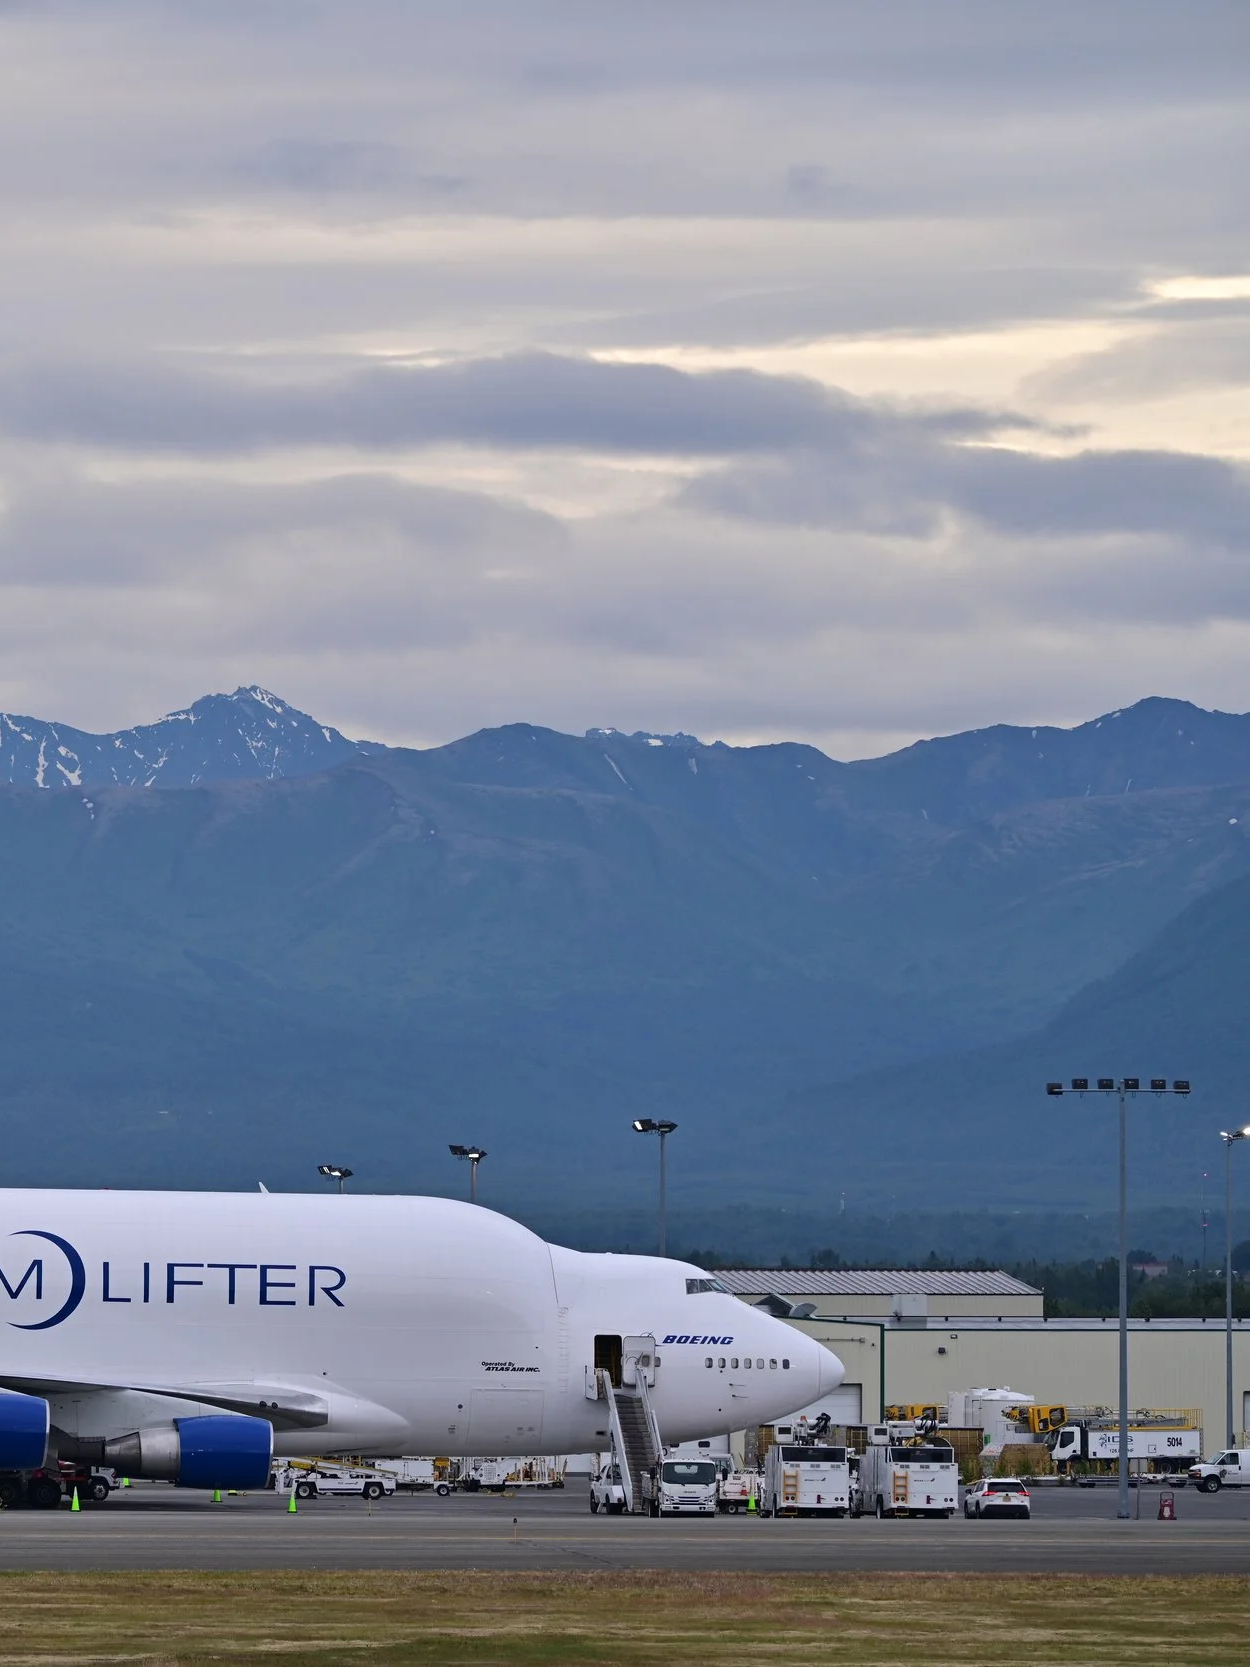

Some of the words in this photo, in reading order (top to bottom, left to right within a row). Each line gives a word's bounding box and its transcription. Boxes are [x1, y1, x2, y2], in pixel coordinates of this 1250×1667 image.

[101, 1260, 347, 1308] LIFTER
[662, 1334, 734, 1345] BOEING
[1166, 1437, 1182, 1447] 5014
